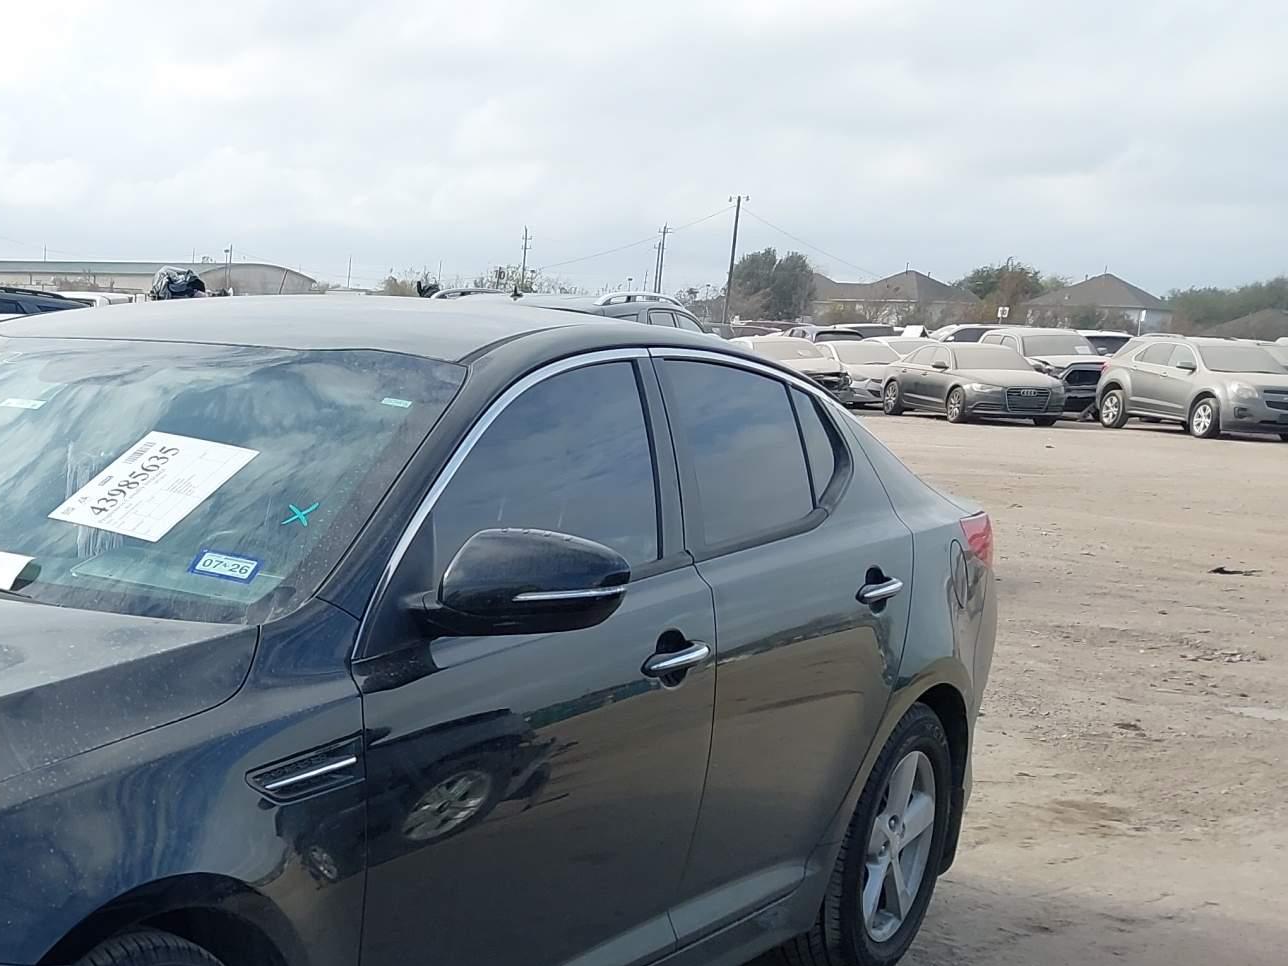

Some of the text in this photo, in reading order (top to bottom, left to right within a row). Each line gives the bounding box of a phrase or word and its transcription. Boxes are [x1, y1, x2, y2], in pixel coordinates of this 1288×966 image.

[89, 445, 180, 516] 43985635
[202, 558, 223, 569] 07
[229, 563, 251, 575] 26
